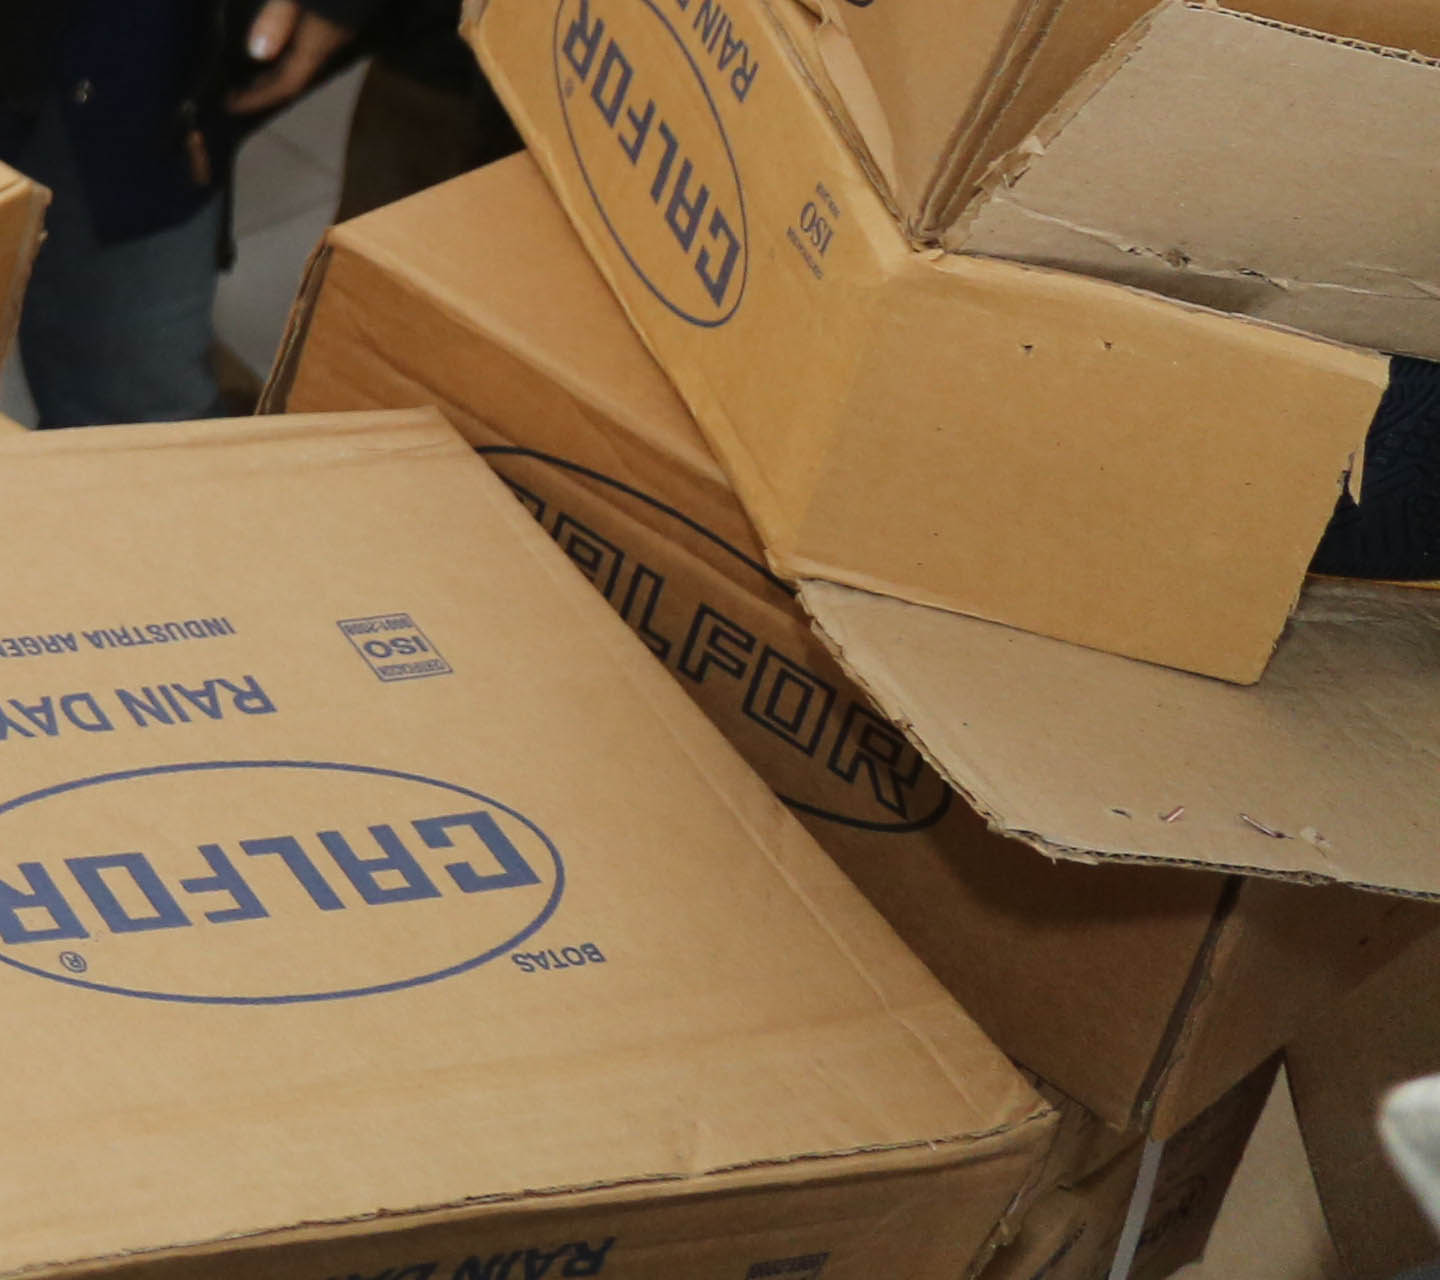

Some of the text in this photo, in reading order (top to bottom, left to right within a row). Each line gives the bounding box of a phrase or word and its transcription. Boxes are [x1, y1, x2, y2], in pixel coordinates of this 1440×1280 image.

[799, 202, 834, 256] ISO
[84, 616, 236, 651] INDUSTRIA
[364, 635, 428, 657] ISO
[116, 675, 277, 729] RAIN
[511, 940, 605, 974] BOTAS
